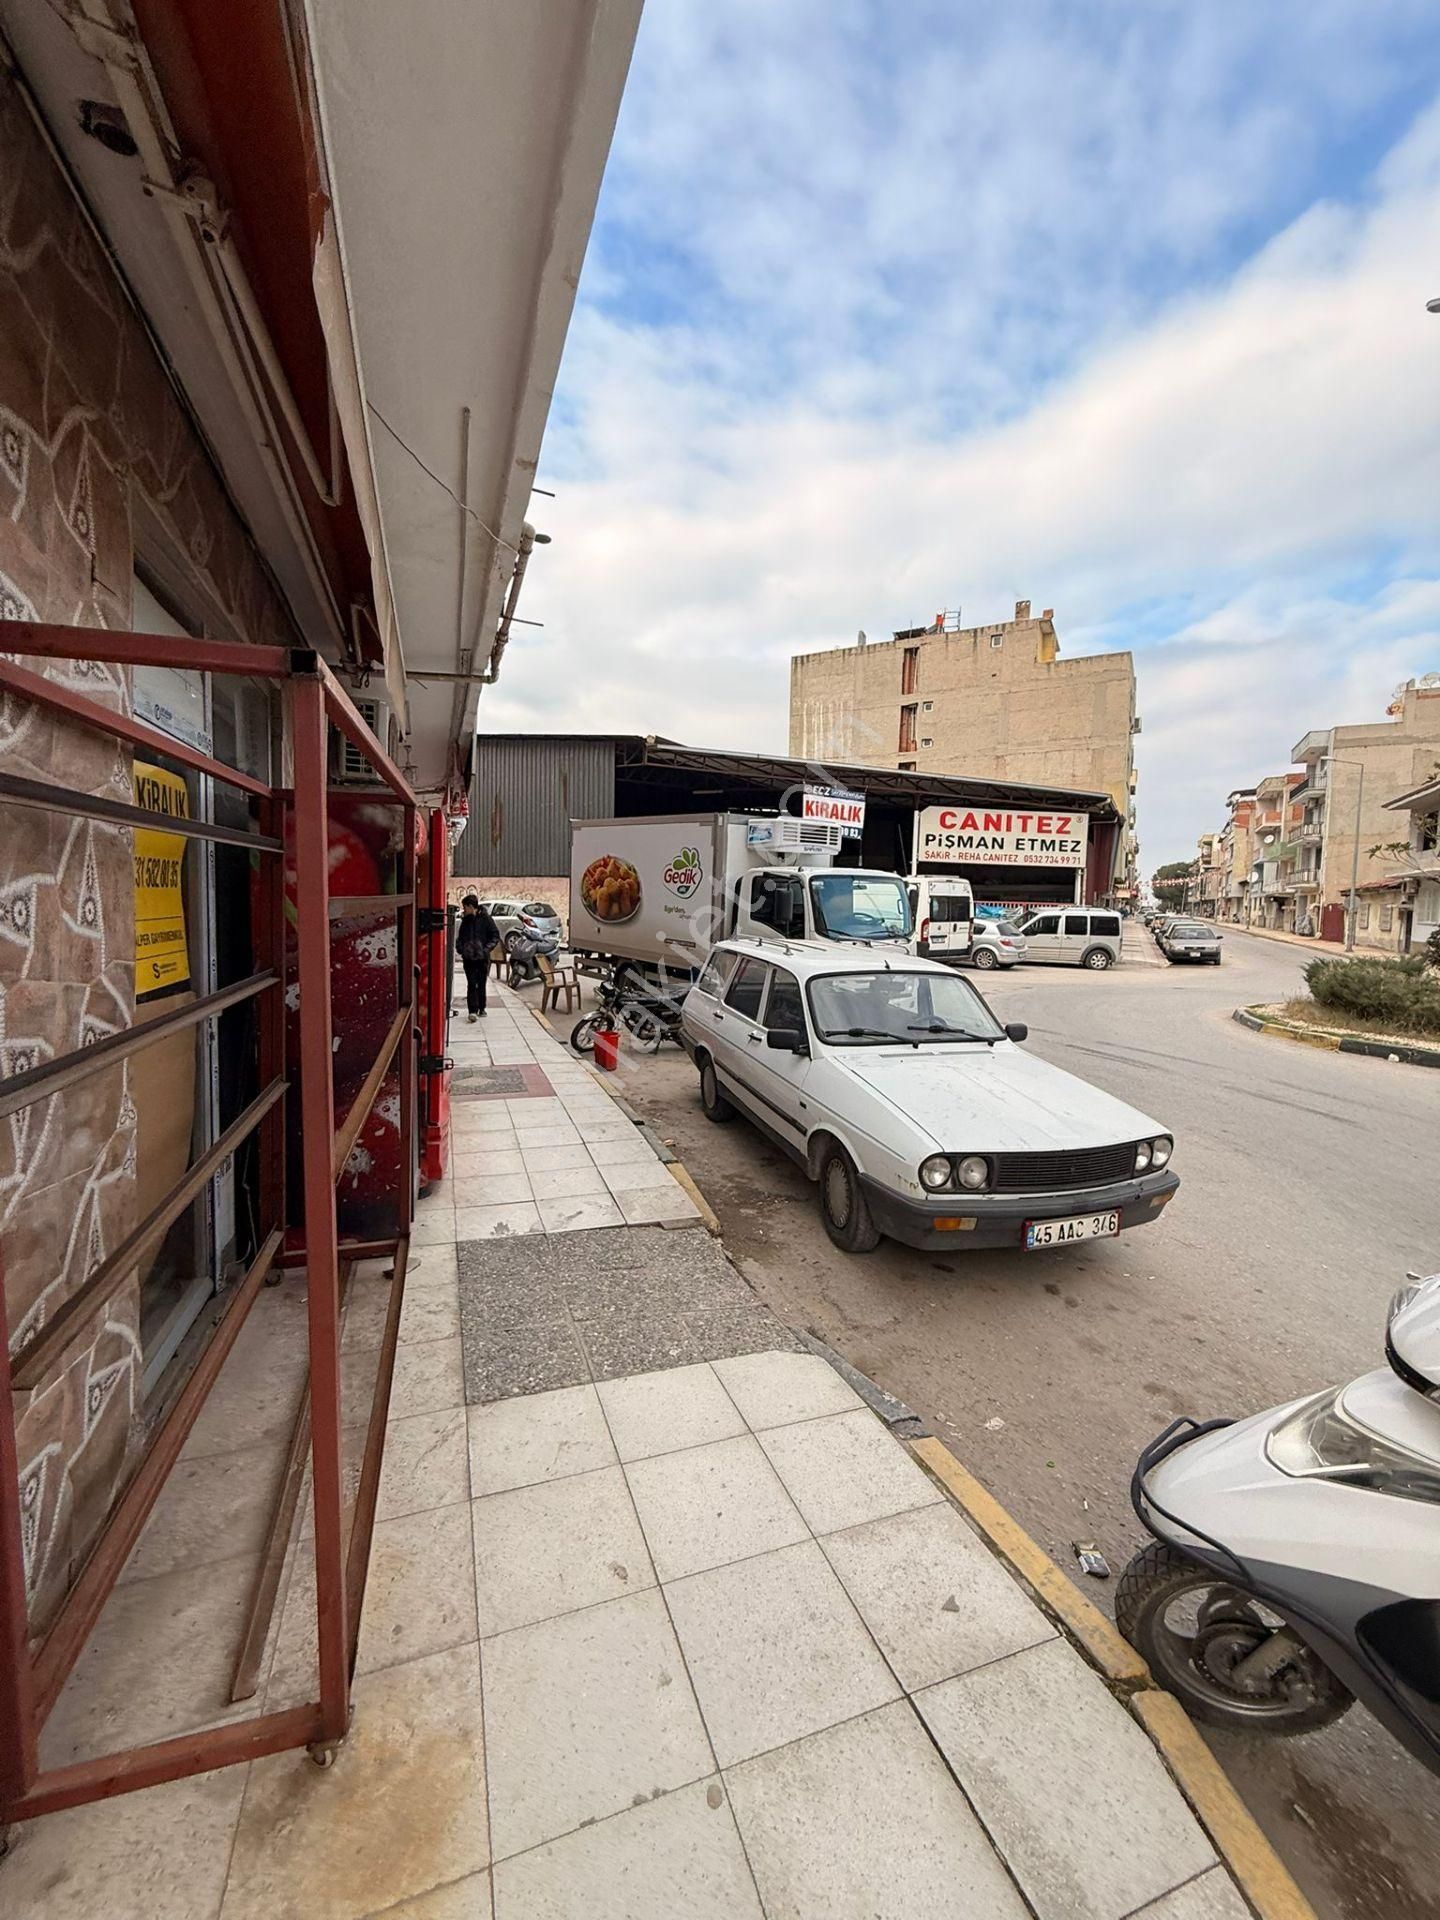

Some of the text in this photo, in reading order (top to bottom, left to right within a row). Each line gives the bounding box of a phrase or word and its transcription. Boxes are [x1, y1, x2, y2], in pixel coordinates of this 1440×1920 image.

[939, 811, 1072, 835] CANITEZ
[1015, 838, 1082, 853] ETMEZ
[958, 852, 981, 861] REHA
[983, 852, 1019, 863] CANITEZ
[1023, 854, 1044, 864] 0532
[1045, 855, 1059, 864] 734
[1060, 856, 1071, 864] 99
[135, 856, 145, 888] 31
[663, 868, 698, 885] Gedik
[1035, 1225, 1052, 1244] 45
[1057, 1221, 1084, 1242] AAC
